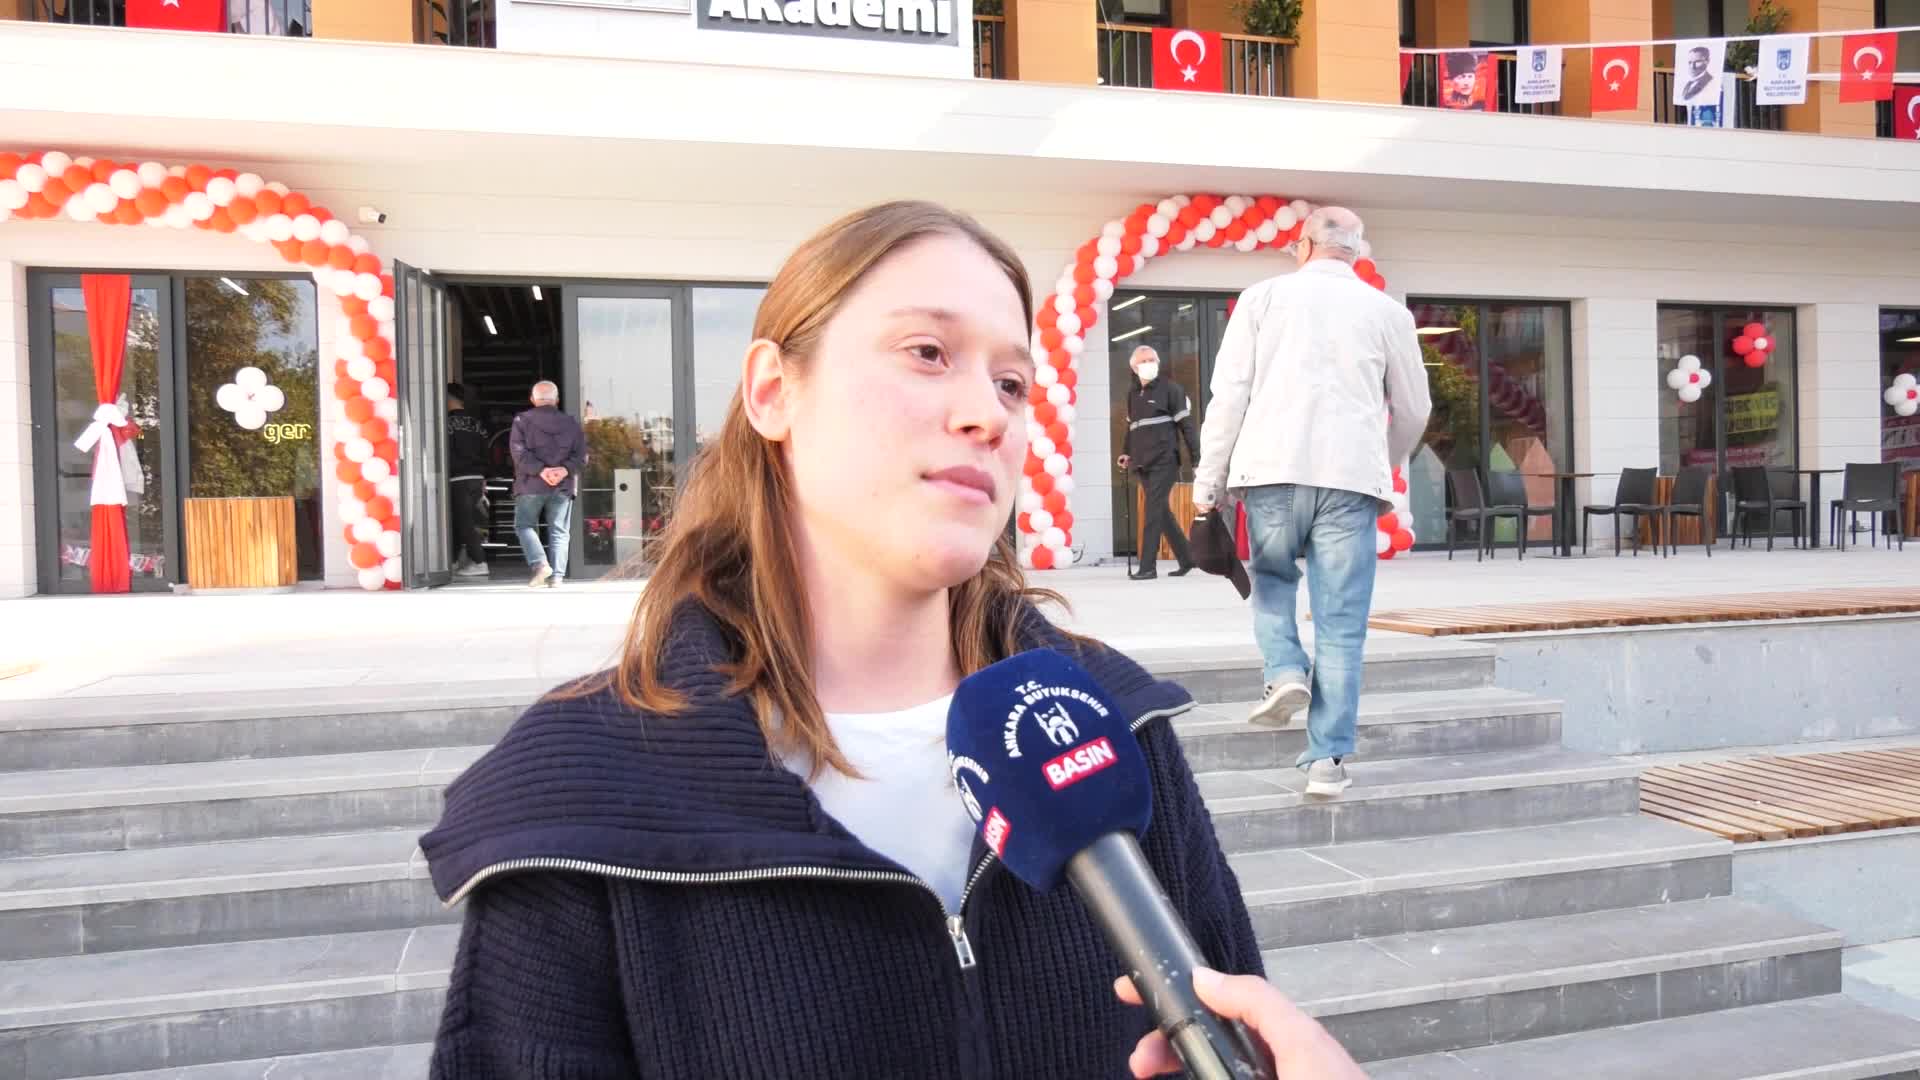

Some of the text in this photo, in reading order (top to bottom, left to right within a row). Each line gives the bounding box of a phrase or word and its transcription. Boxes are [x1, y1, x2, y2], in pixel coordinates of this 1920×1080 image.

[1015, 681, 1042, 695] T.C.
[1004, 704, 1027, 758] ANKARA
[1046, 741, 1113, 785] BASIN
